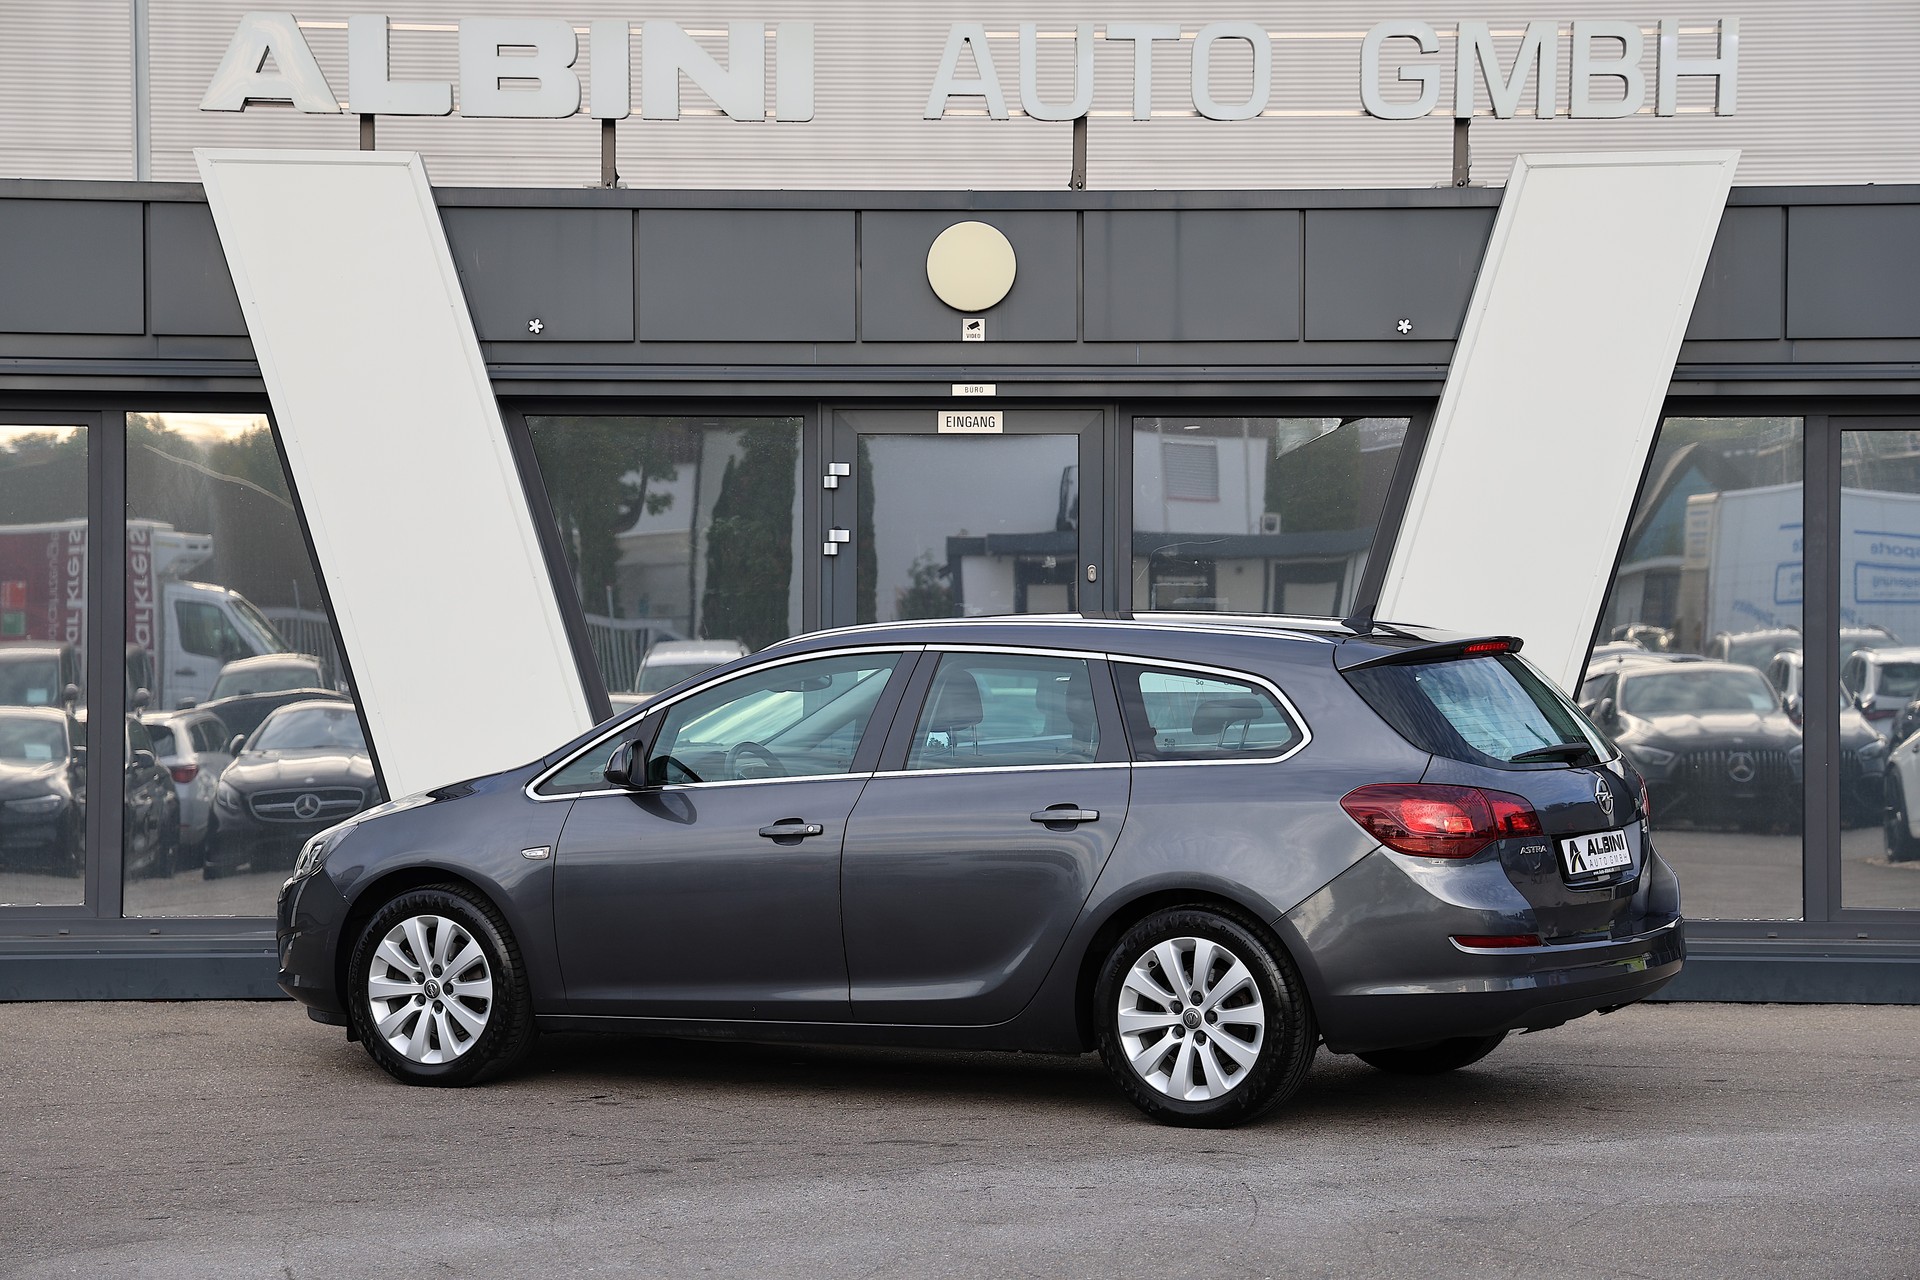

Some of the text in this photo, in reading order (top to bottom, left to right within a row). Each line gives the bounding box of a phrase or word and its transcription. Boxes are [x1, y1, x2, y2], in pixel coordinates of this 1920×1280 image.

[200, 12, 1741, 122] ALBINI AUTO GMBH
[946, 416, 995, 428] EINGANG
[1520, 845, 1548, 855] ASTRA
[1587, 833, 1625, 857] ALBINI
[1589, 853, 1629, 868] AUTO GMBH
